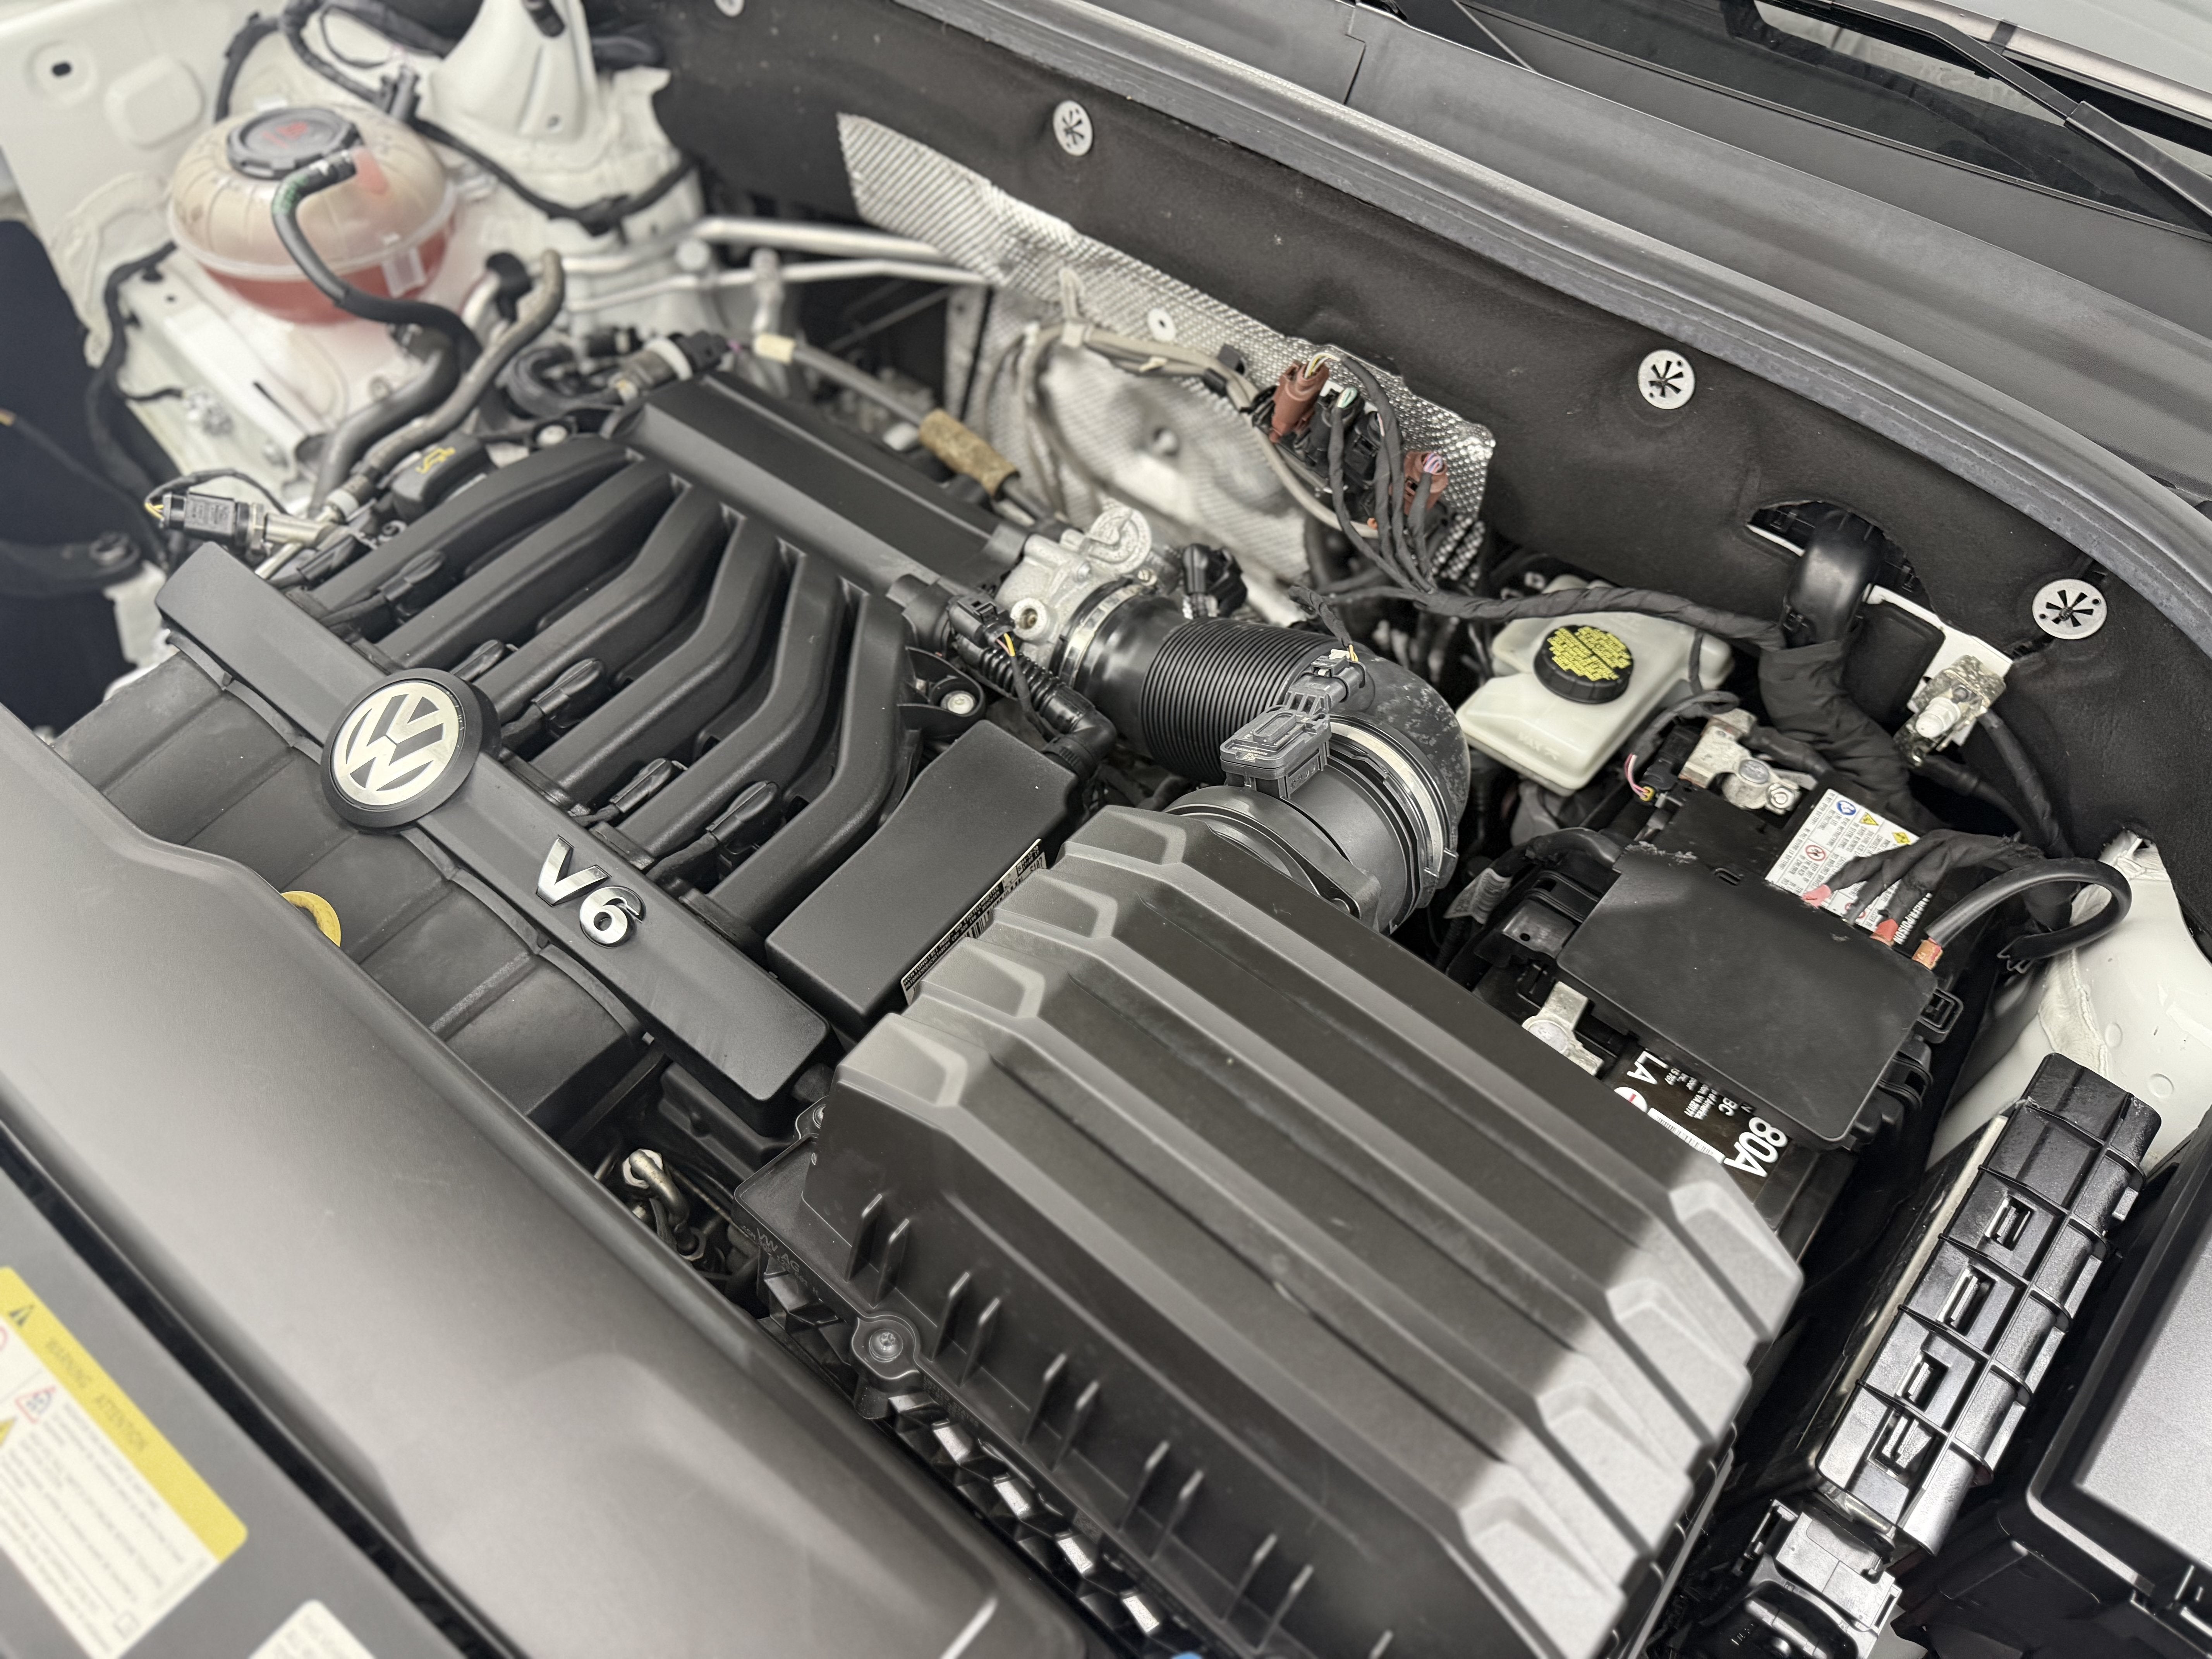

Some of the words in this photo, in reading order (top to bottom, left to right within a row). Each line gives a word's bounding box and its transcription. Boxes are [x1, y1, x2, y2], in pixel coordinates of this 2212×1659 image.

[536, 835, 646, 948] V6
[1693, 1093, 1705, 1104] VA
[756, 1227, 778, 1252] VW
[781, 1253, 800, 1273] AG
